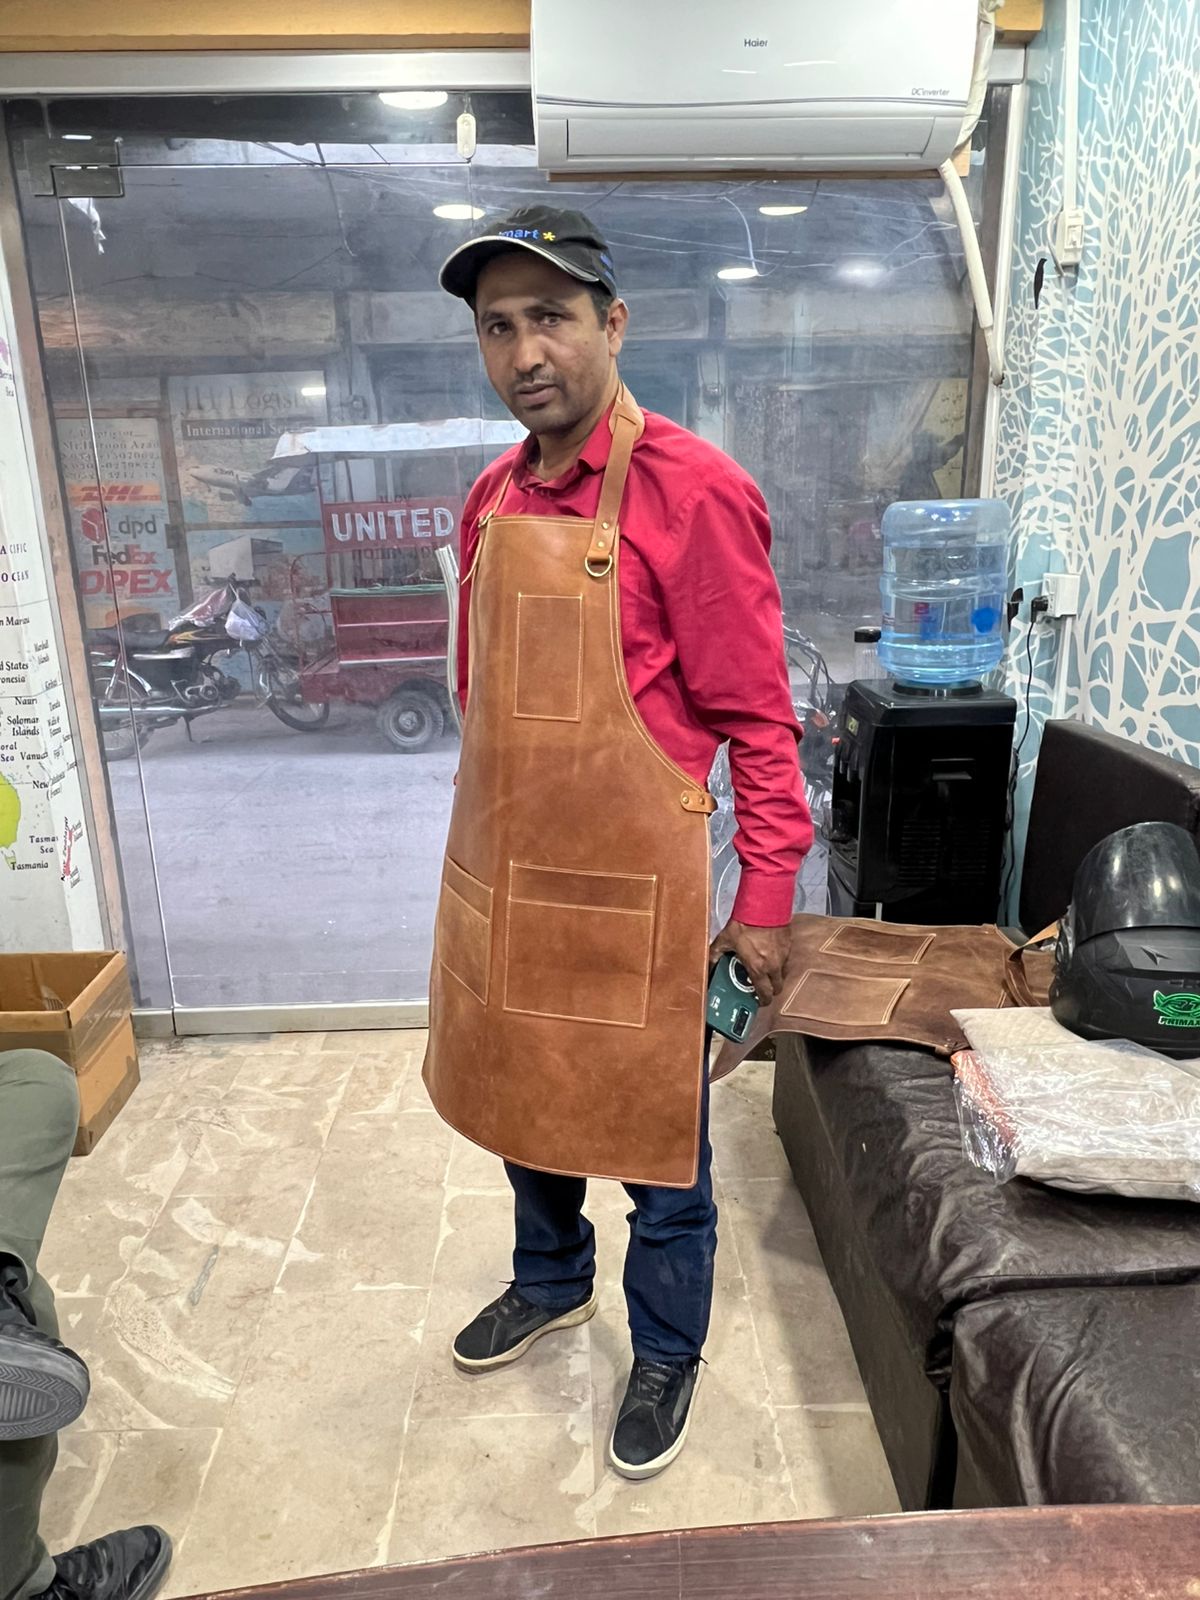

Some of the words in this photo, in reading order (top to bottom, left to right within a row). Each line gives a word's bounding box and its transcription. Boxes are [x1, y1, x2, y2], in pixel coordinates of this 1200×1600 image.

[744, 38, 768, 47] Haier
[187, 424, 266, 437] International
[80, 485, 152, 501] DHL
[118, 513, 157, 539] dpd
[331, 507, 454, 541] UNITED
[92, 544, 157, 566] FedEx
[80, 569, 173, 594] DPEX
[6, 661, 29, 671] States
[12, 726, 40, 737] Islands
[32, 780, 50, 790] New
[40, 845, 54, 854] Sea
[10, 860, 49, 871] Tasmania
